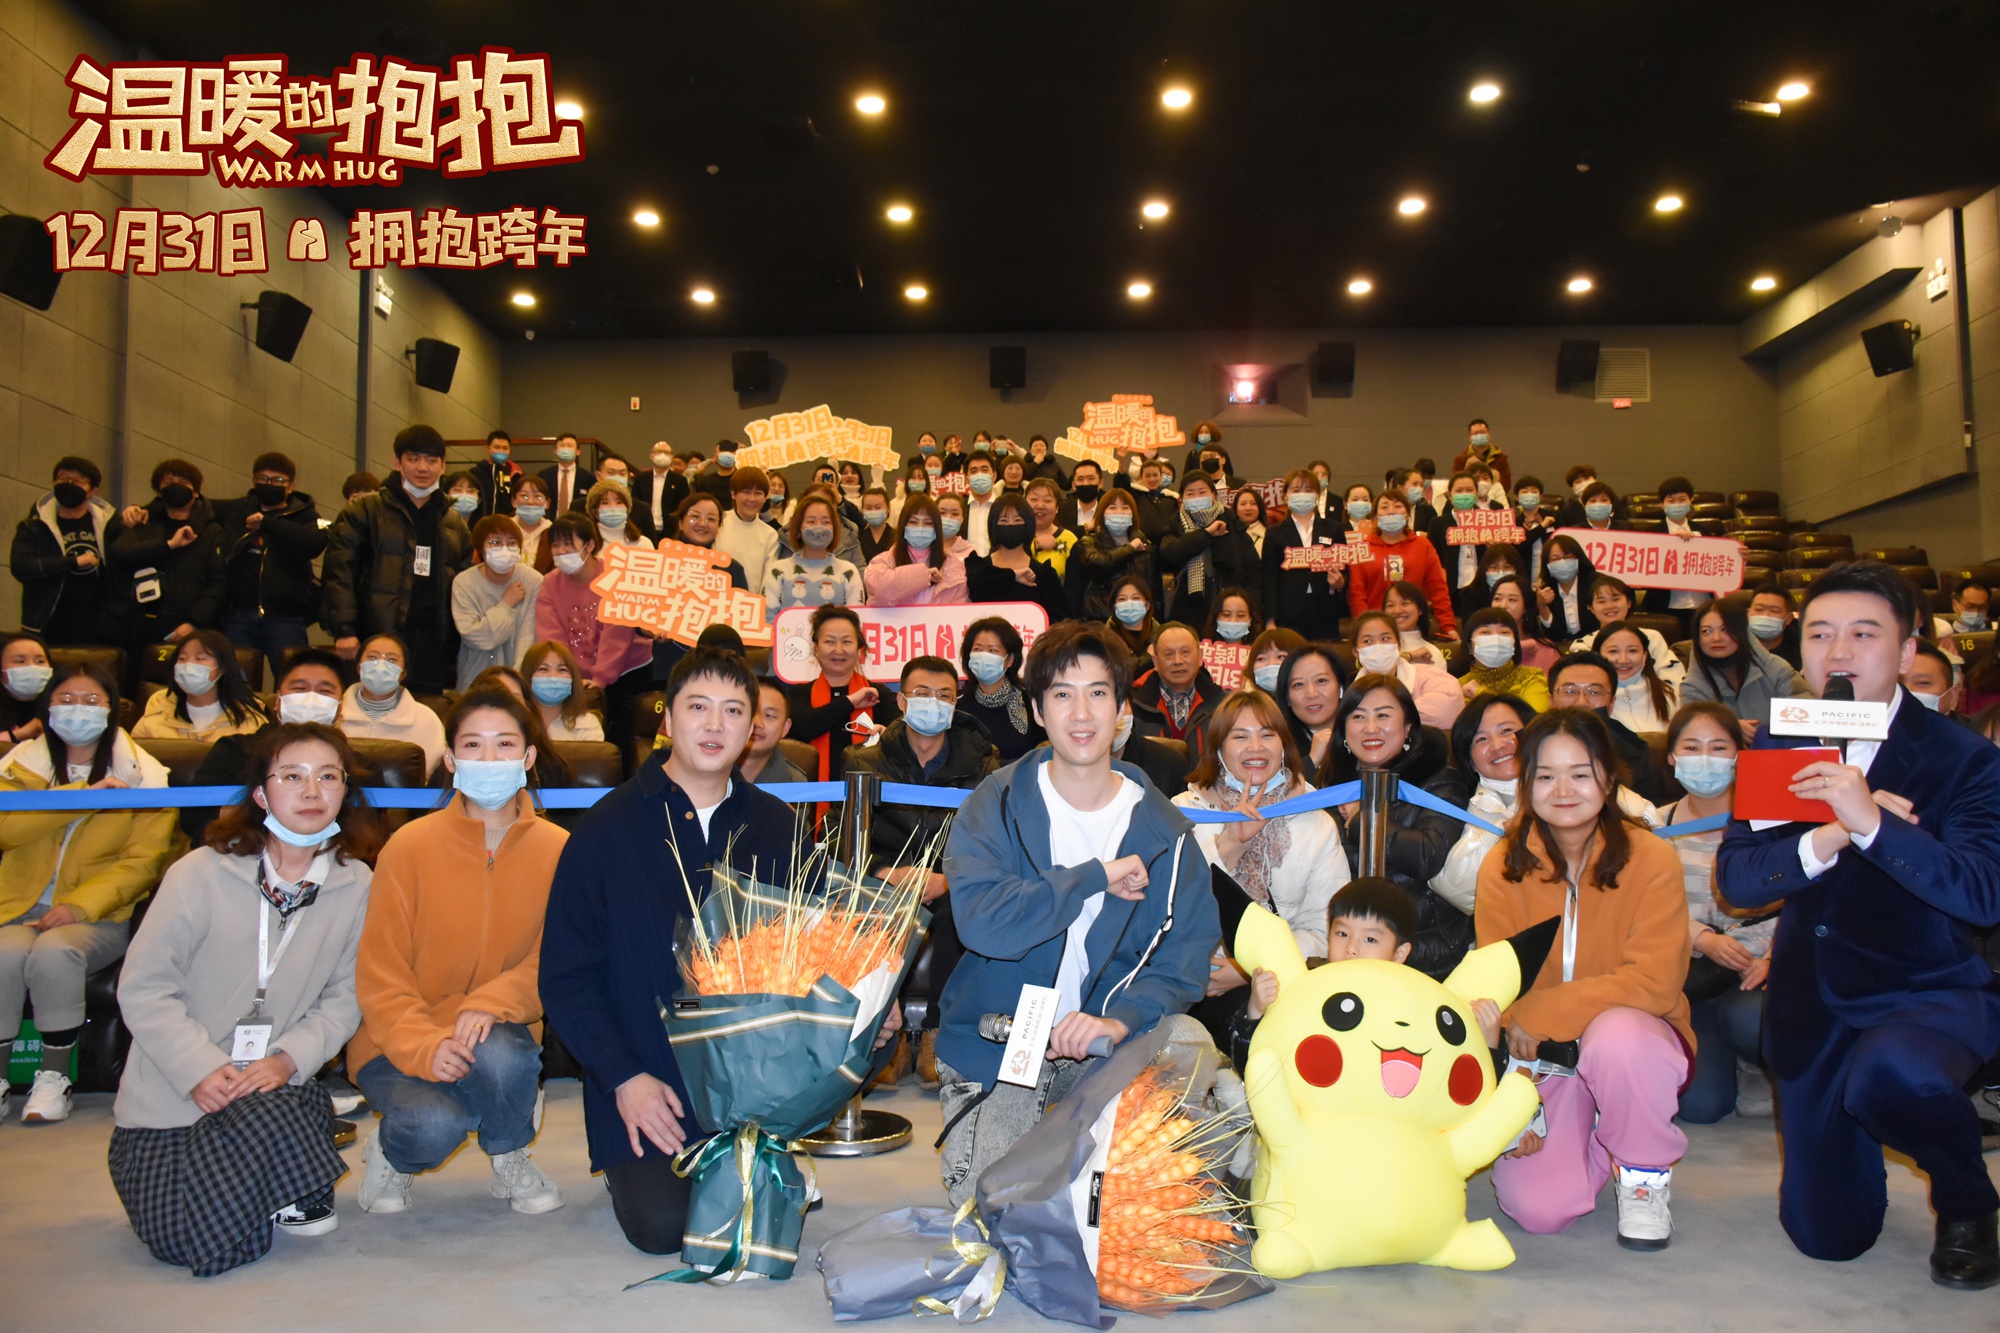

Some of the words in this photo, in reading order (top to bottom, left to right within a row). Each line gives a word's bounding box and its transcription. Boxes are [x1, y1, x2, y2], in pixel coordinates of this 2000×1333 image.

[747, 408, 835, 445] 12月31日
[1083, 402, 1154, 431] 温暖的
[1089, 434, 1119, 445] HUG
[1093, 428, 1119, 436] WARM
[1120, 416, 1183, 450] 抱抱
[1458, 510, 1514, 527] 12月31日
[1448, 528, 1479, 544] 拥抱
[1493, 527, 1525, 544] 跨年
[1282, 542, 1376, 569] 温暖的抱抱
[1585, 541, 1660, 576] 12月31日
[1682, 551, 1736, 578] 拥抱跨年
[596, 545, 727, 600] 温暖的
[613, 591, 661, 607] WARM
[603, 601, 659, 625] HUG
[657, 590, 773, 642] 抱抱
[1960, 639, 1976, 651] 16
[654, 700, 664, 714] 6
[1821, 711, 1872, 719] PACIFIC
[1021, 998, 1038, 1040] PACIFIC
